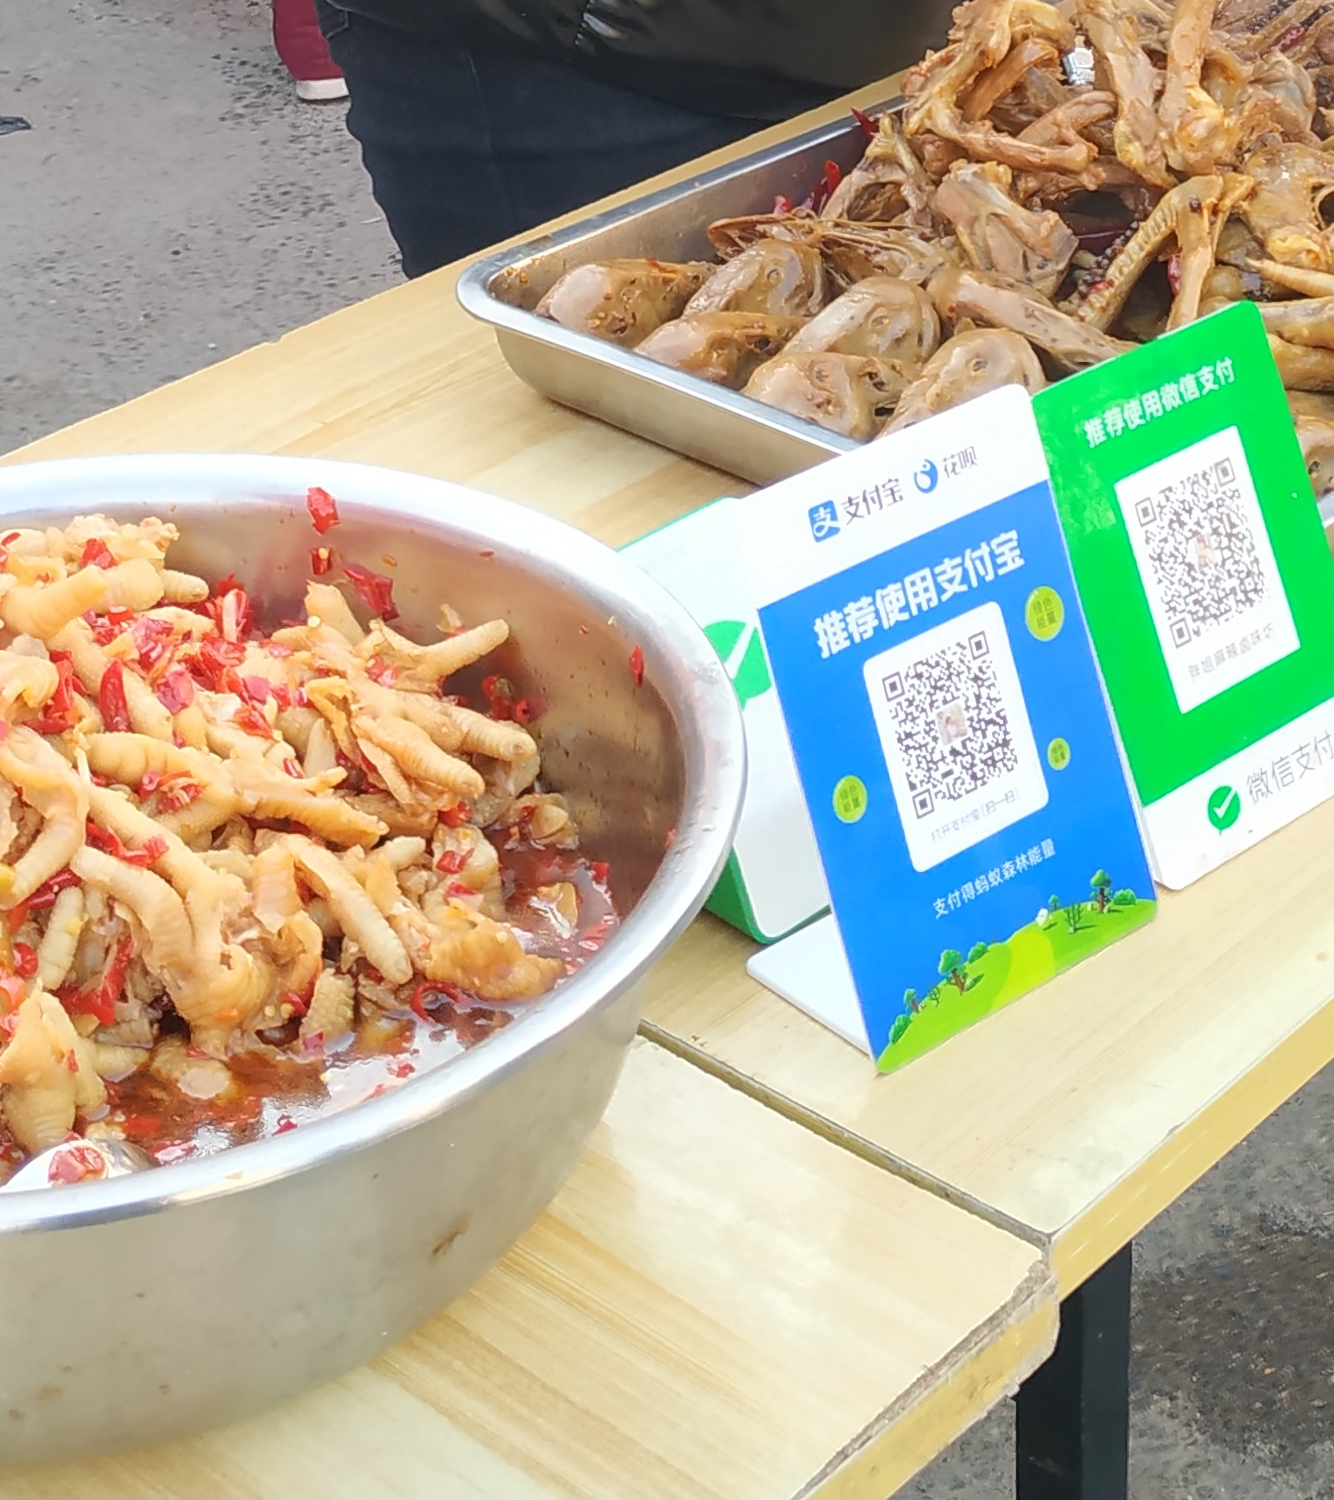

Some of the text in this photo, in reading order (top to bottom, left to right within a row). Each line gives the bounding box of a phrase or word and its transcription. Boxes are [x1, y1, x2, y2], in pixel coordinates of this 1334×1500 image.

[1083, 356, 1236, 449] 推荐使用微信支付
[841, 477, 904, 525] 支付宝
[942, 445, 979, 479] 花呗
[813, 529, 1026, 660] 推荐使用支付宝
[1246, 729, 1334, 806] 微信支付
[932, 837, 1057, 920] 支付得蚂蚁森林能量
